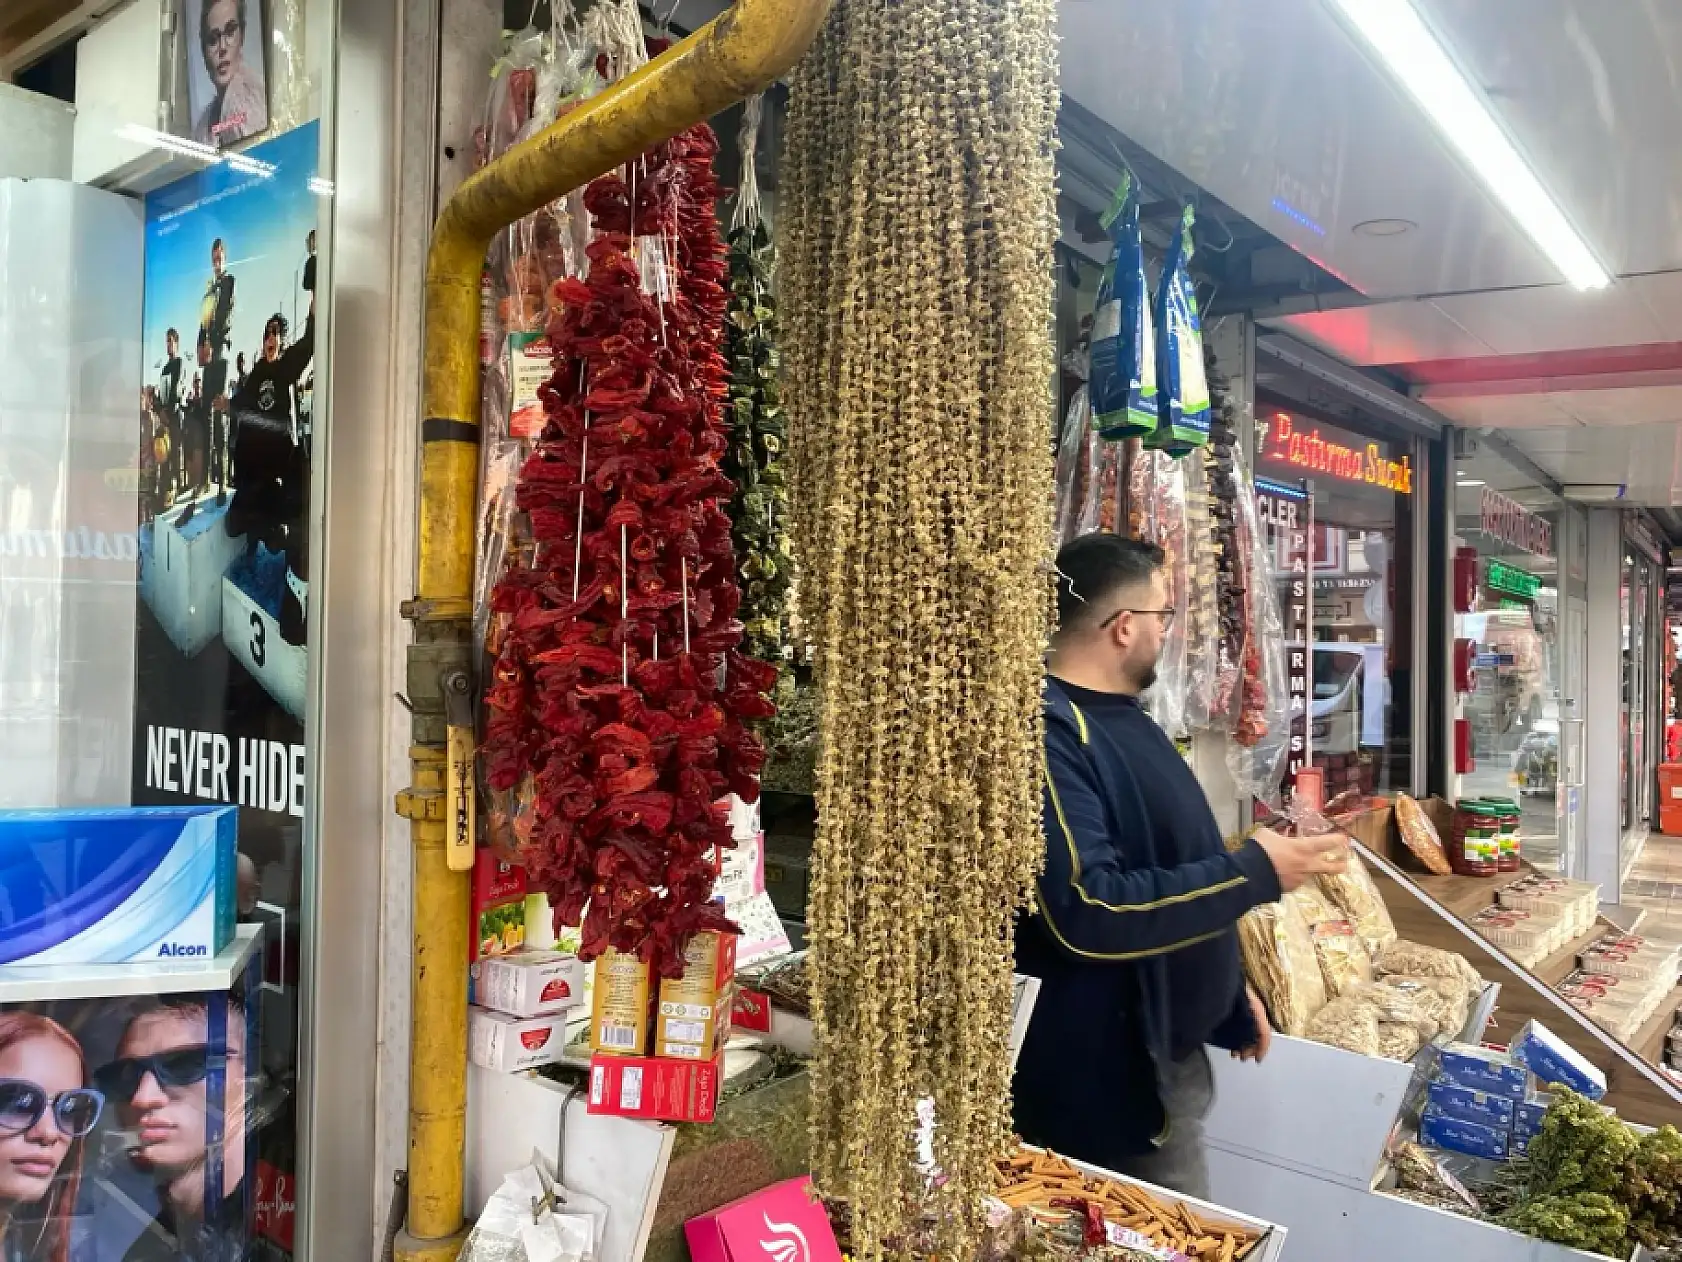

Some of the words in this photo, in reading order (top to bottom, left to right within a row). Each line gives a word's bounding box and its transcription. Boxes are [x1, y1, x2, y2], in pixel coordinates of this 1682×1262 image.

[249, 611, 265, 668] 3
[1290, 534, 1306, 711] PASTIRMA
[146, 725, 230, 803] NEVER
[239, 736, 306, 818] HIDE
[157, 942, 207, 957] Alcon
